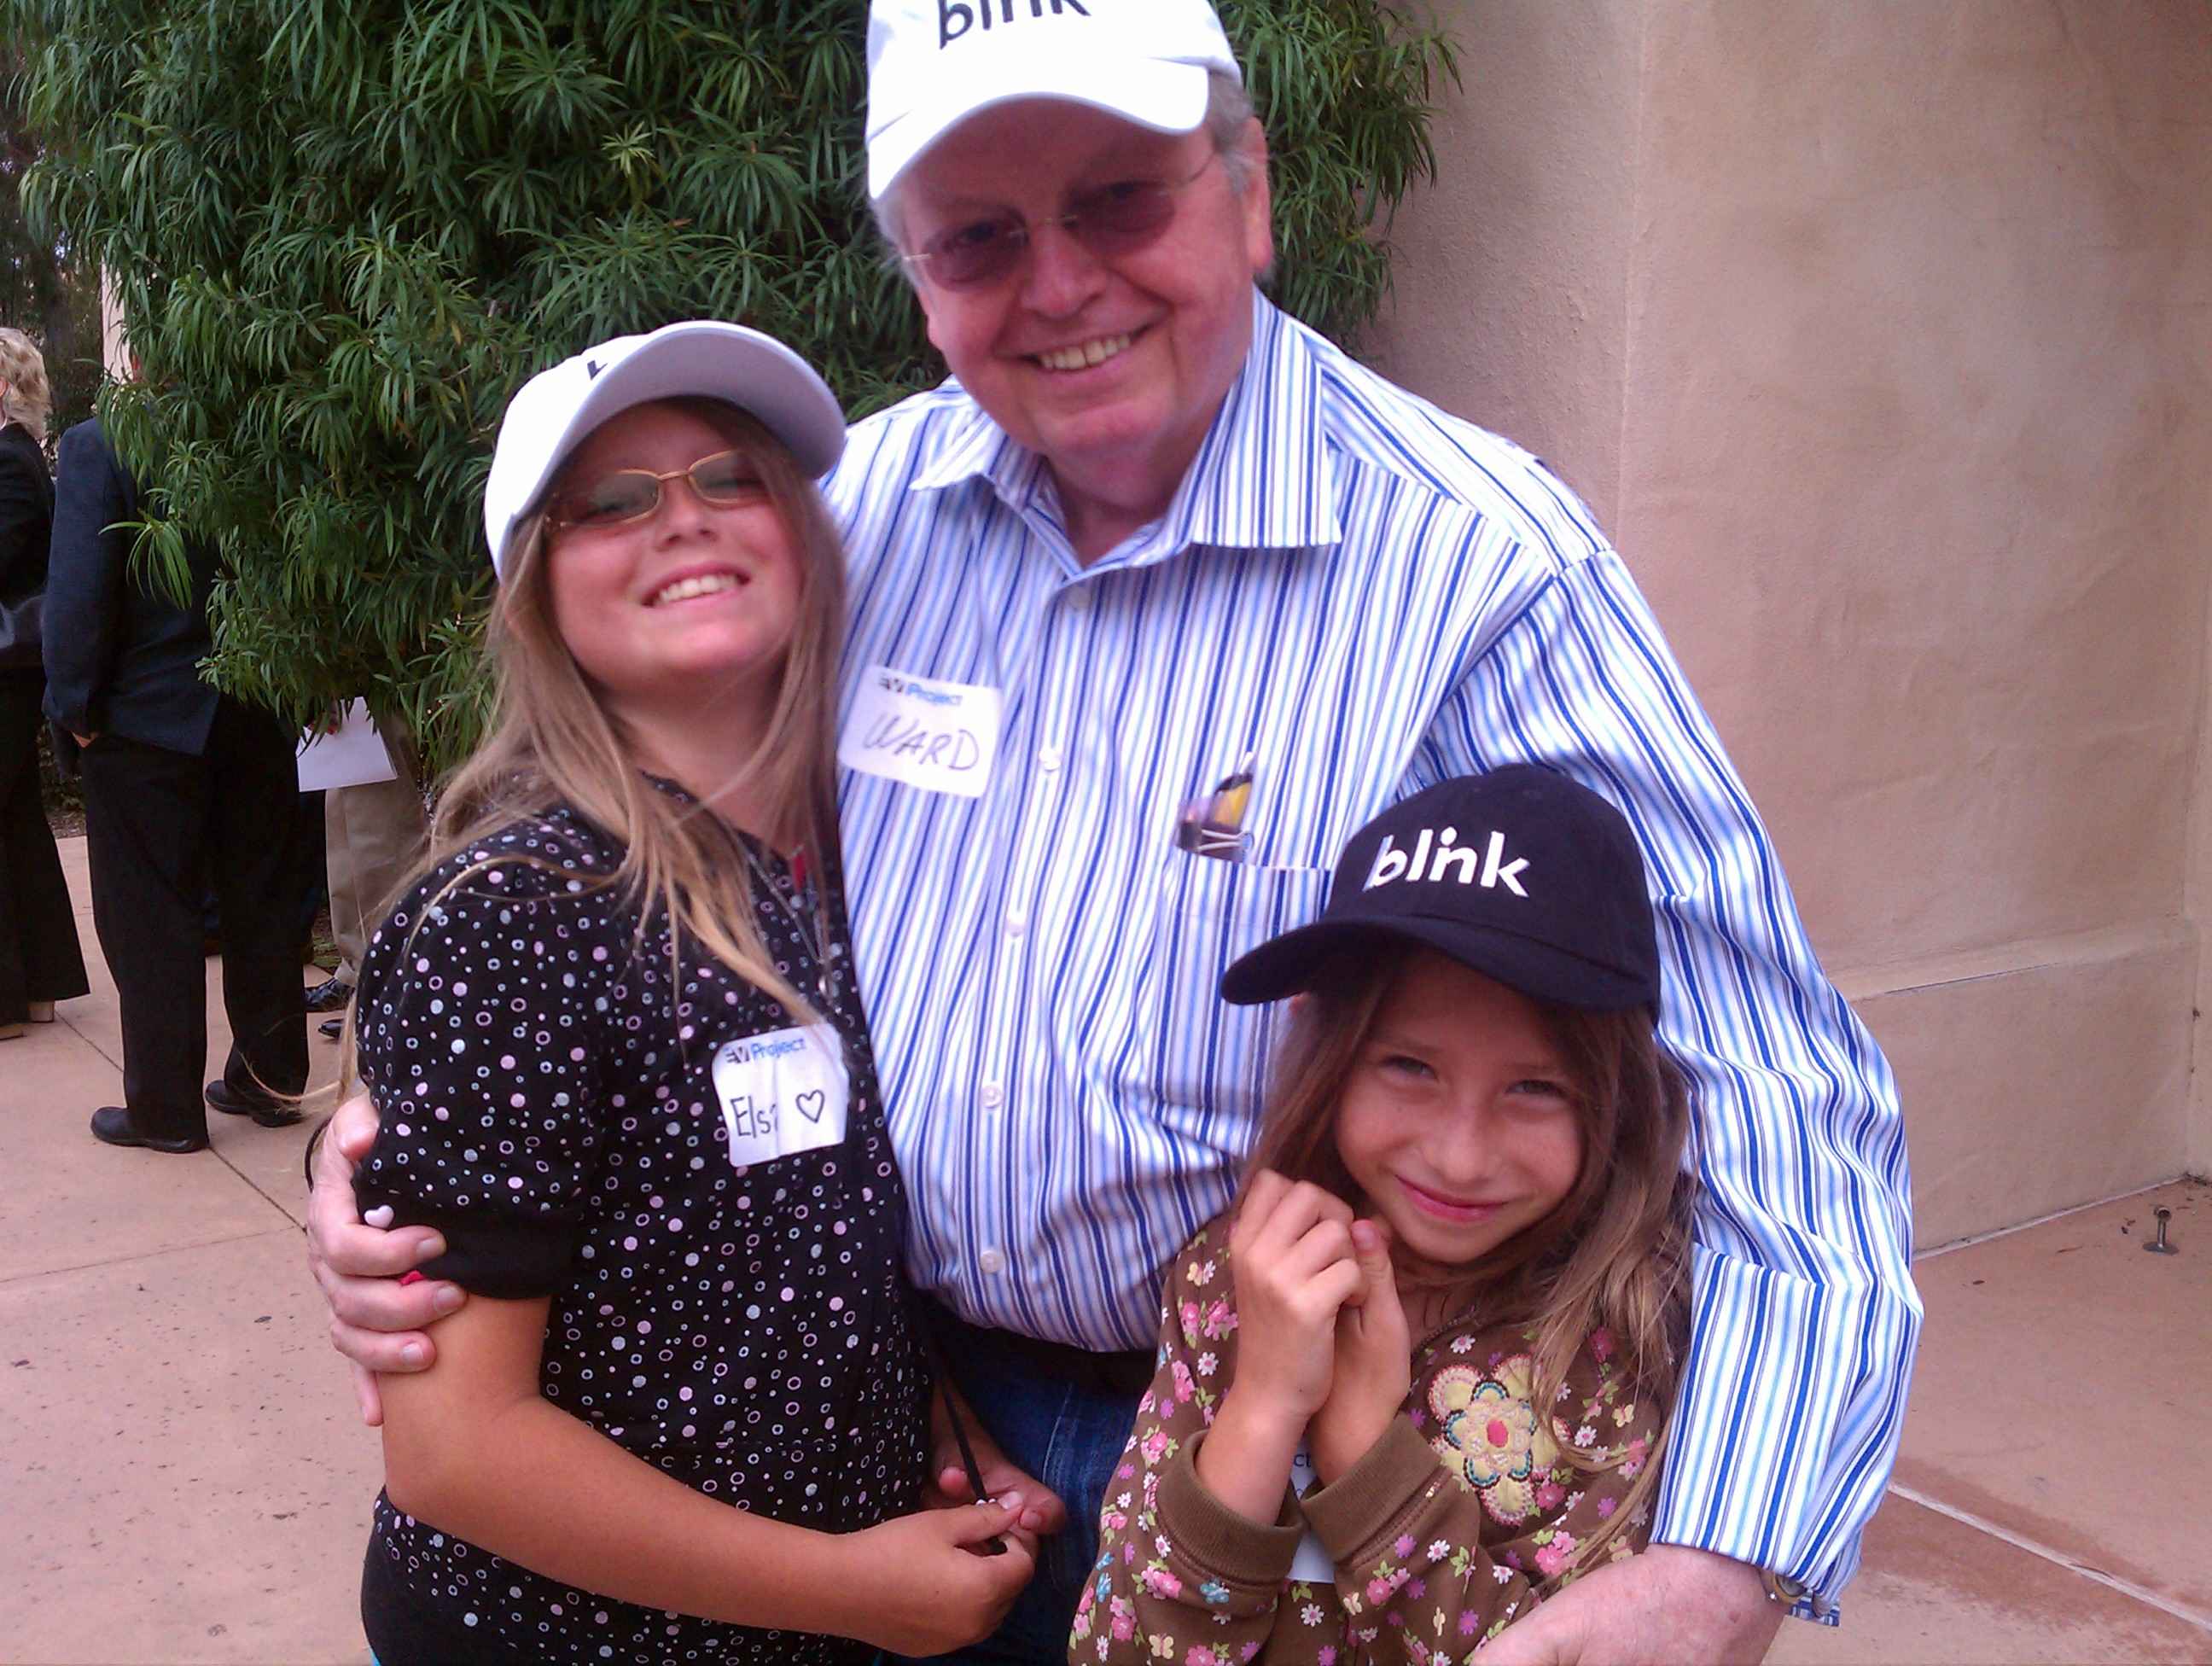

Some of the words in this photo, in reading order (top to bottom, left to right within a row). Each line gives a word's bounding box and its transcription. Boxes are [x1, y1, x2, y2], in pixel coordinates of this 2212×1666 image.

[938, 0, 1091, 50] bln
[862, 712, 980, 771] WARD
[1362, 826, 1531, 898] blink
